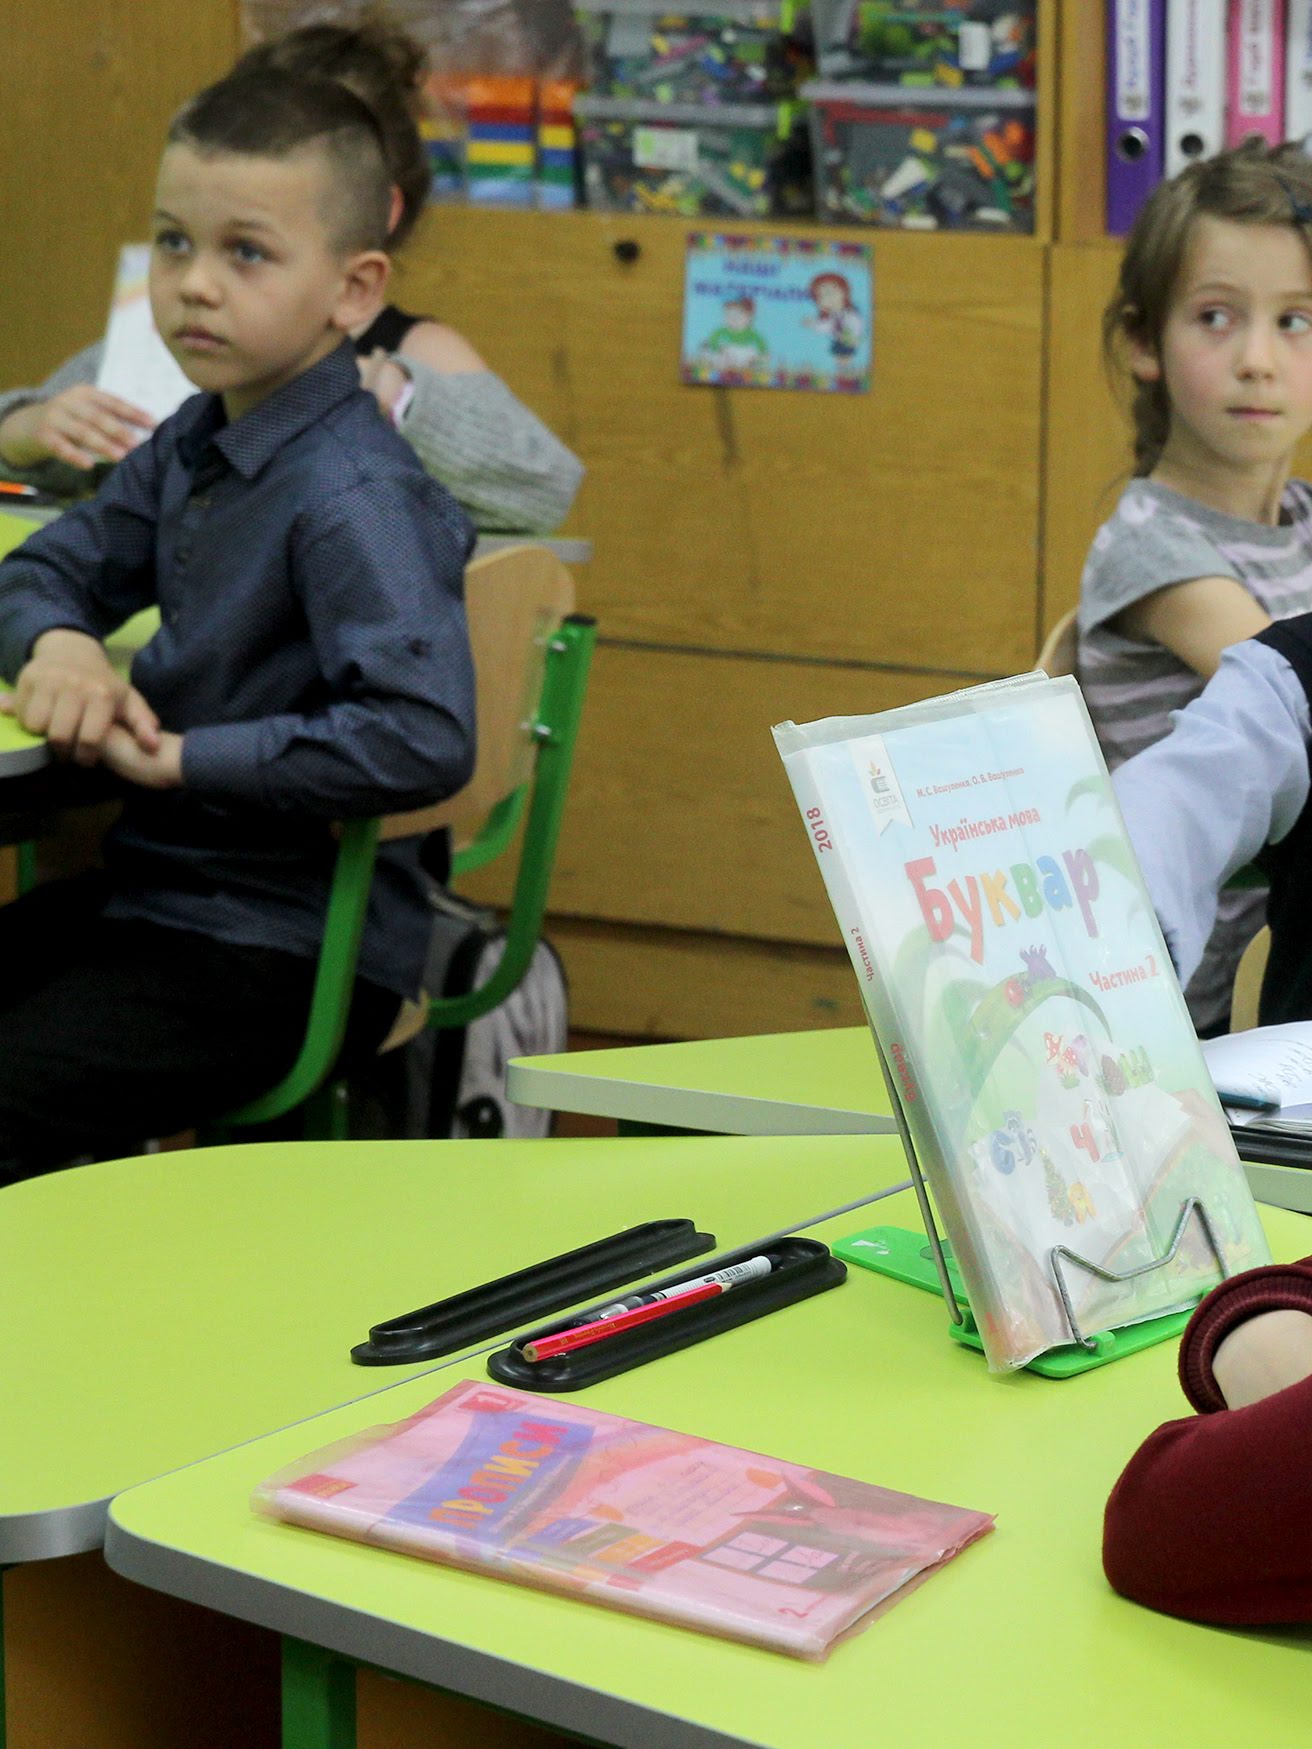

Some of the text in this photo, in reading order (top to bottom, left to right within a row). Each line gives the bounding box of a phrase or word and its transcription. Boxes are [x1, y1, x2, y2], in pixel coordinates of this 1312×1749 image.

[806, 807, 833, 853] 2018
[929, 807, 1041, 852] Українська мова
[904, 849, 1099, 965] Буквар
[850, 927, 875, 982] Частина 2
[1089, 955, 1161, 993] Частина 2
[428, 1421, 569, 1531] ПРОПИСИ
